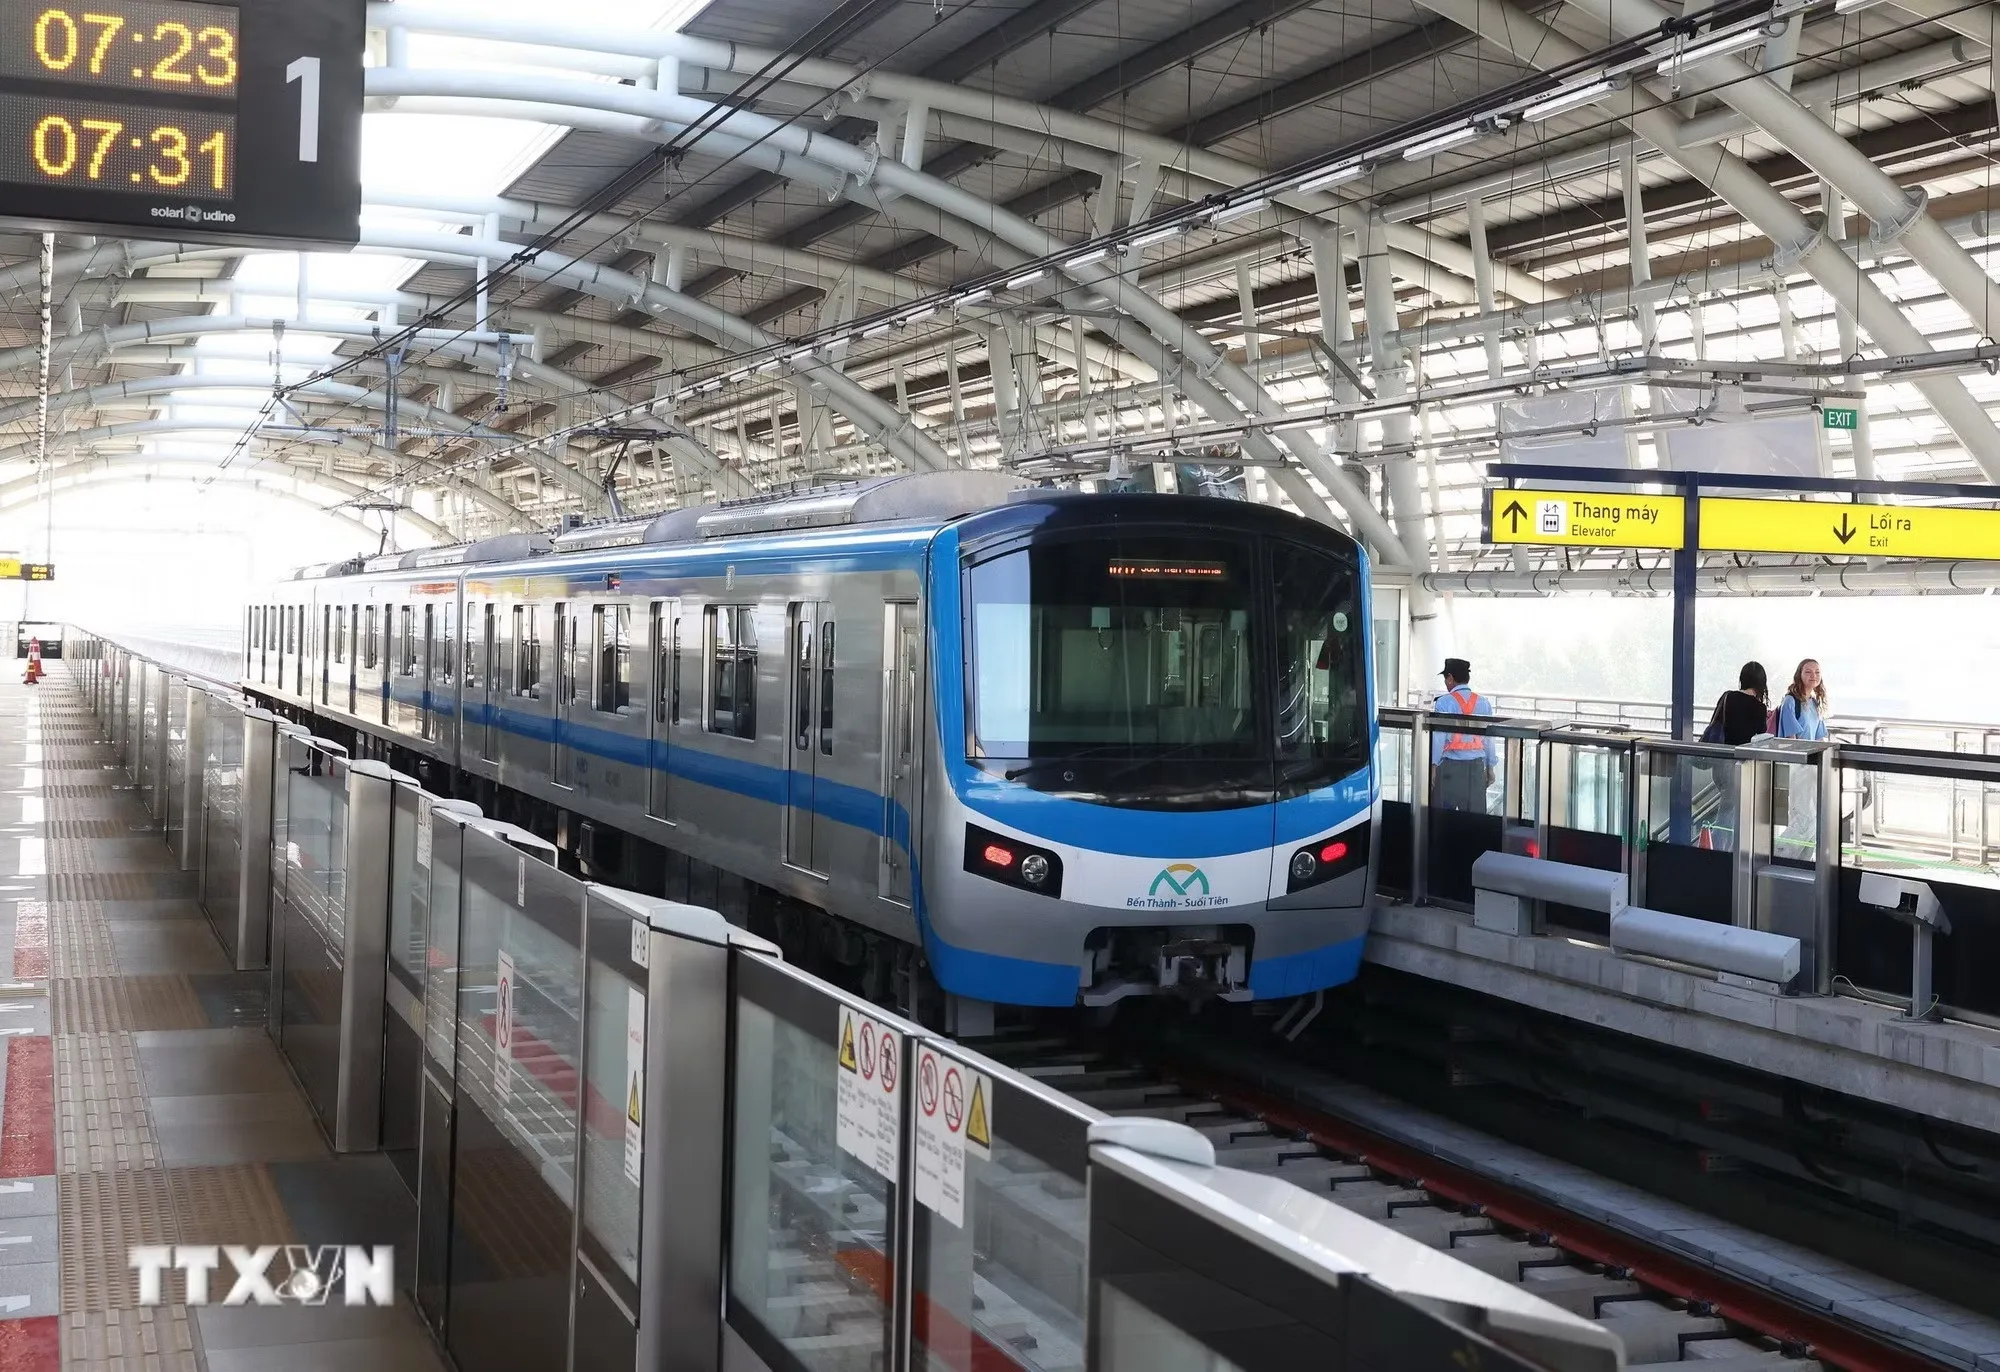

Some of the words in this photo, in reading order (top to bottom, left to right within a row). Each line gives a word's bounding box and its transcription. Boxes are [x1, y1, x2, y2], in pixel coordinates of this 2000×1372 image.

[33, 9, 237, 85] 07:23
[286, 56, 321, 163] 1
[33, 116, 225, 190] 07:31
[151, 206, 184, 218] solari
[203, 210, 236, 222] udine
[1828, 411, 1852, 427] EXIT
[1572, 501, 1620, 523] Thang
[1626, 504, 1659, 524] máy
[1870, 512, 1892, 530] Lối
[1896, 519, 1911, 531] ra
[1571, 524, 1616, 537] Elevator
[1870, 535, 1889, 547] Exit
[1126, 897, 1145, 907] Bến
[1147, 898, 1177, 908] Thành
[1185, 896, 1206, 907] Suối
[1208, 896, 1228, 906] Tiên
